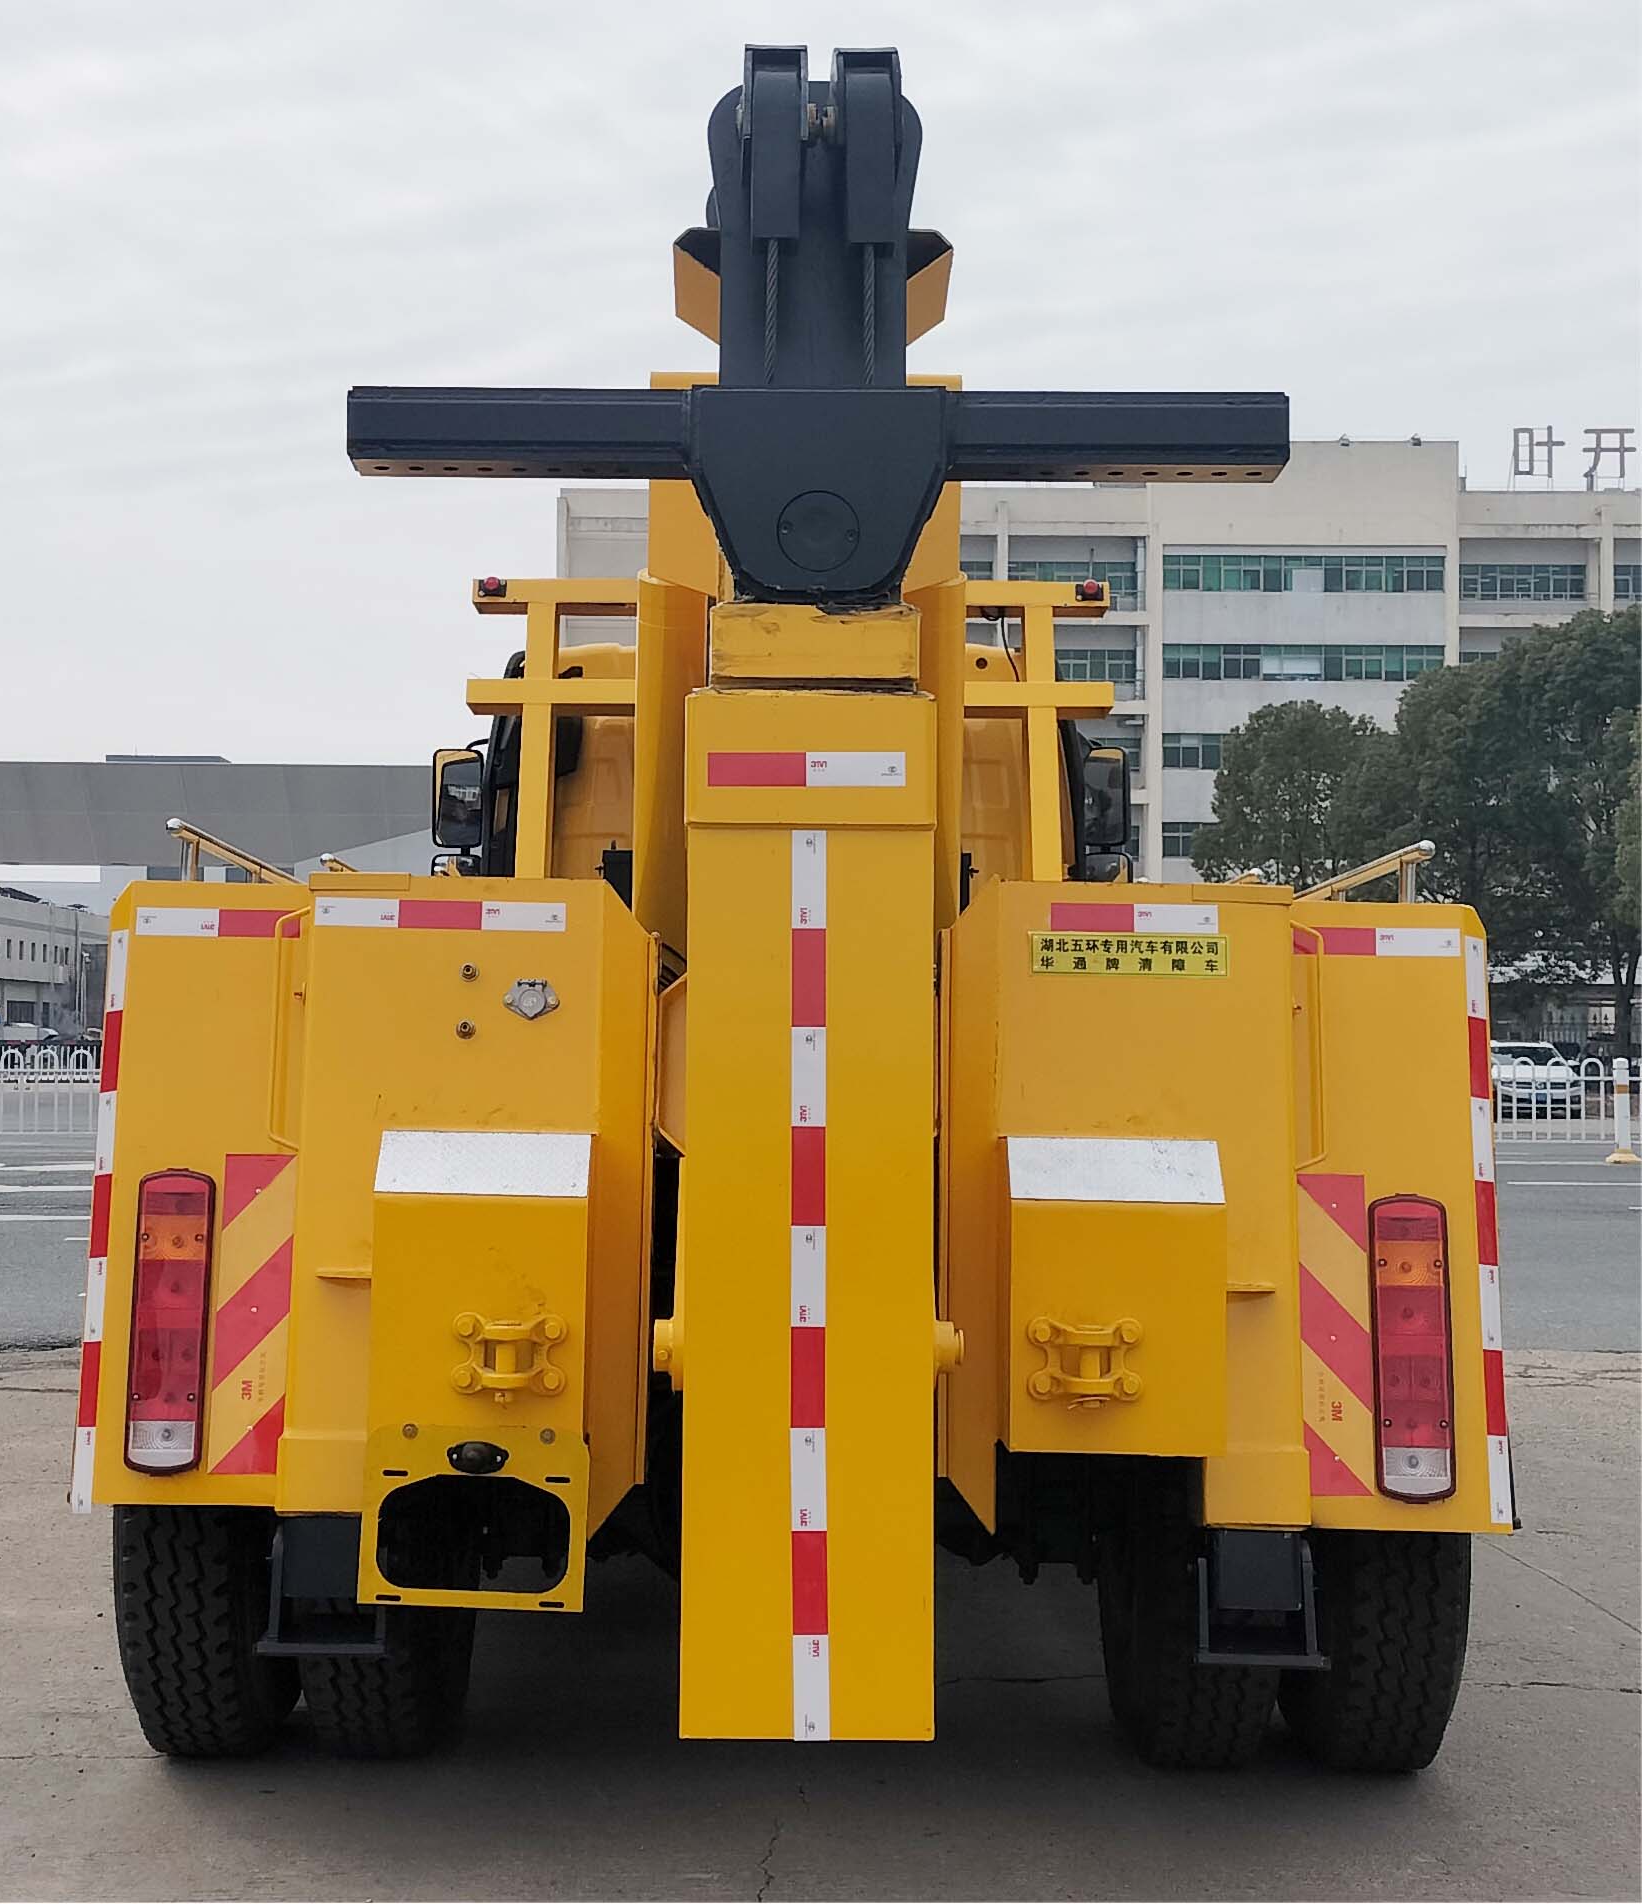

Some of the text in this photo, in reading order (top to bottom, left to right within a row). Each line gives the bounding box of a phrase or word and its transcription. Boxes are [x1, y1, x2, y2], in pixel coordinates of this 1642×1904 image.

[1513, 425, 1637, 478] 叶开
[1040, 938, 1219, 955] 湖北五环专用汽车有限公司
[241, 1380, 253, 1401] 3M
[1330, 1400, 1343, 1422] 3M
